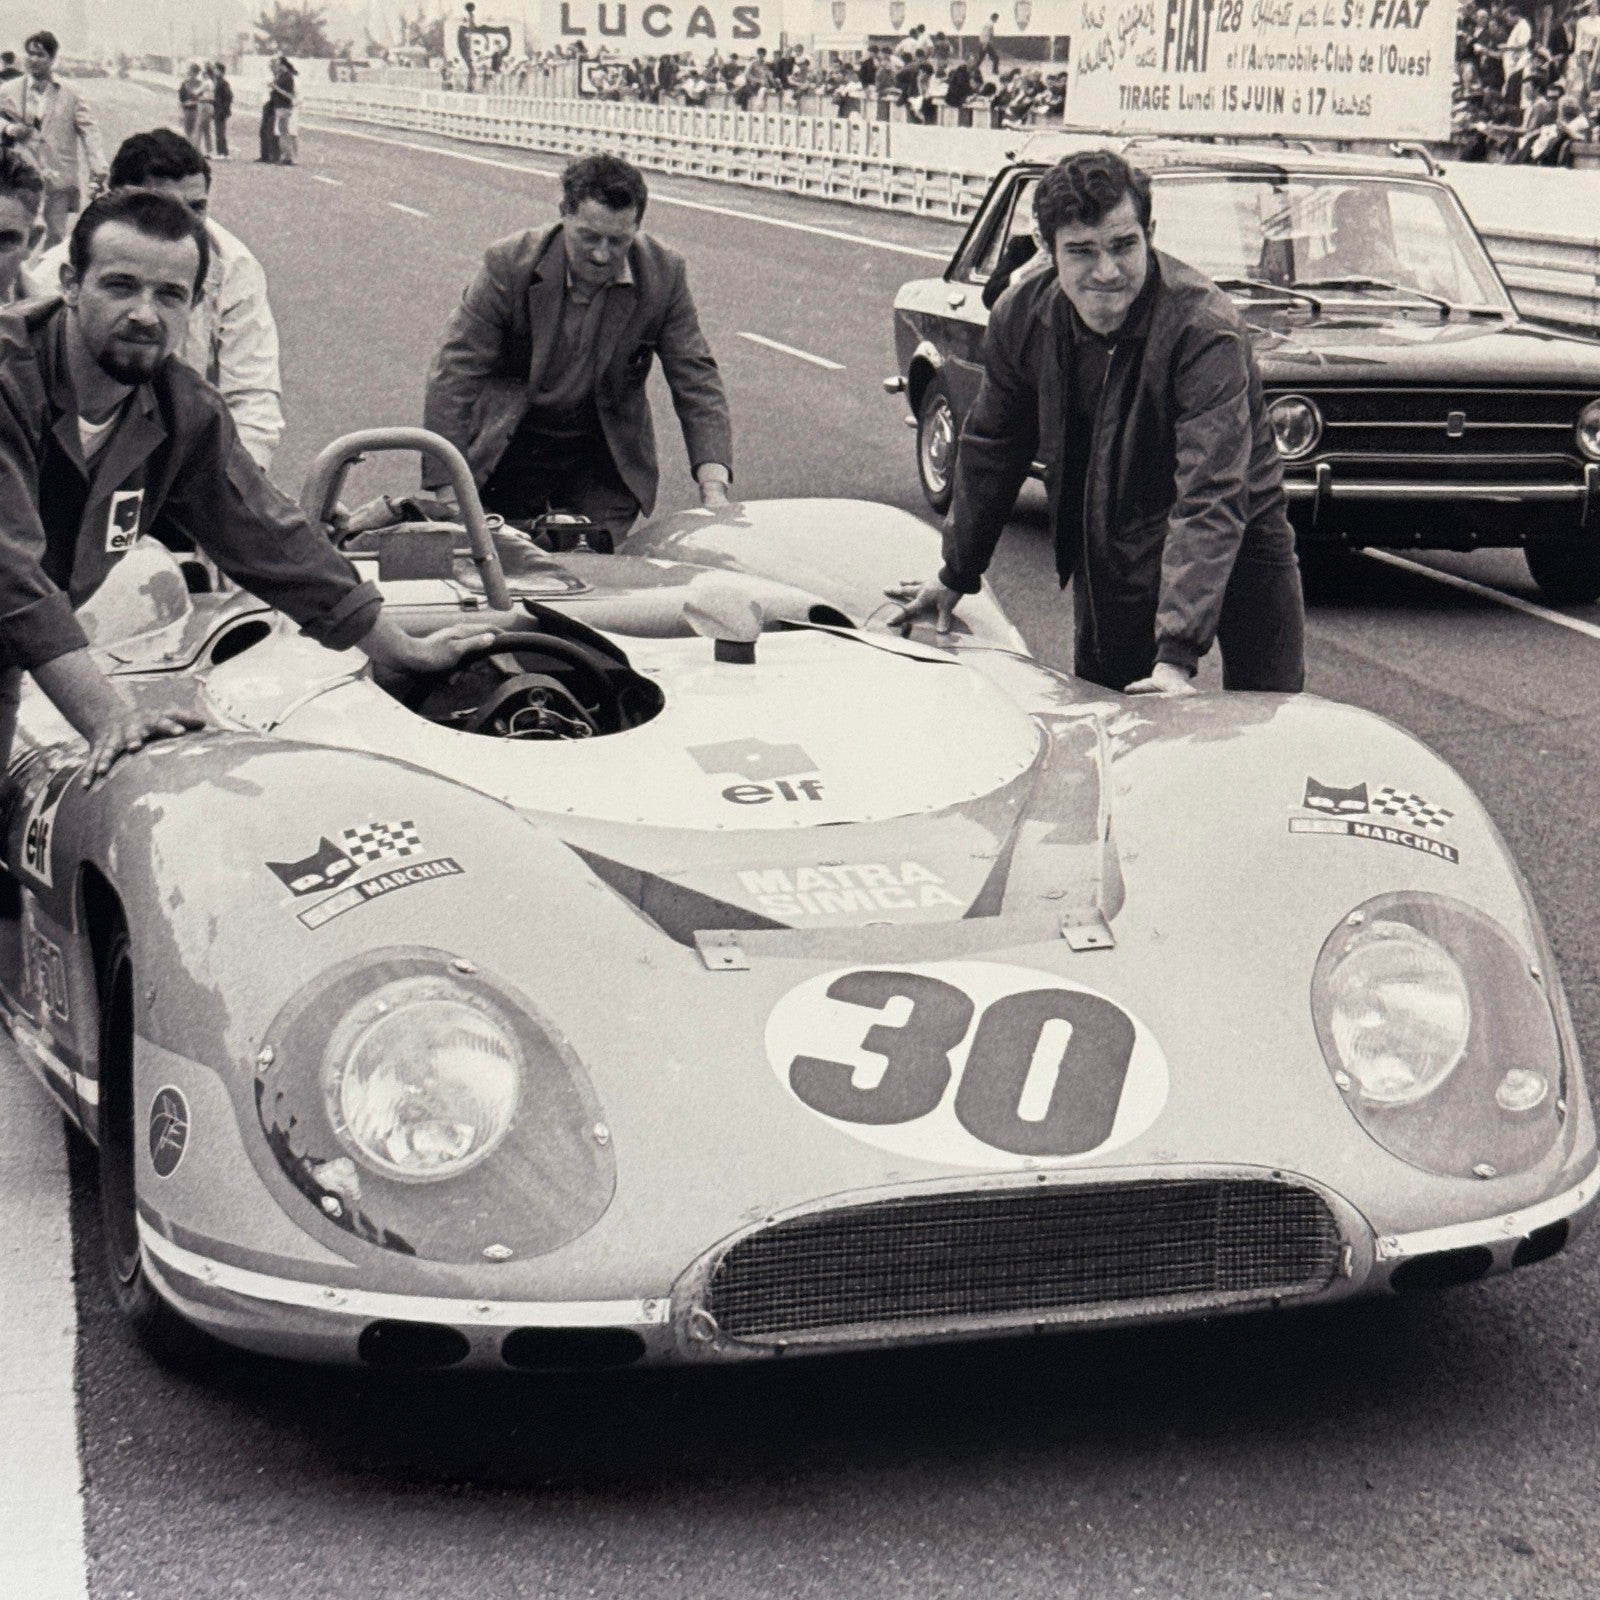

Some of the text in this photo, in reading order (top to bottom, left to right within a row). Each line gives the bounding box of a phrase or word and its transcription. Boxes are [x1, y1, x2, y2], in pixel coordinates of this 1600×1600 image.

[561, 2, 761, 39] LUCAS
[1369, 0, 1430, 29] FIAT
[1162, 0, 1244, 73] FIAT 128
[1226, 42, 1431, 76] et l'Automobile-Club de l'Ouest
[1119, 84, 1170, 111] TIRAGE
[1179, 84, 1215, 111] Lundi
[1222, 85, 1238, 112] 15
[1241, 85, 1285, 114] JUIN
[1308, 87, 1326, 116] 17
[111, 532, 136, 548] elf
[722, 780, 824, 805] elf
[26, 817, 50, 876] elf
[1353, 823, 1454, 861] MARCHAL
[361, 859, 460, 897] MARCHAL
[736, 860, 946, 896] MATRA
[757, 882, 968, 916] SIMCA
[789, 970, 1136, 1157] 30
